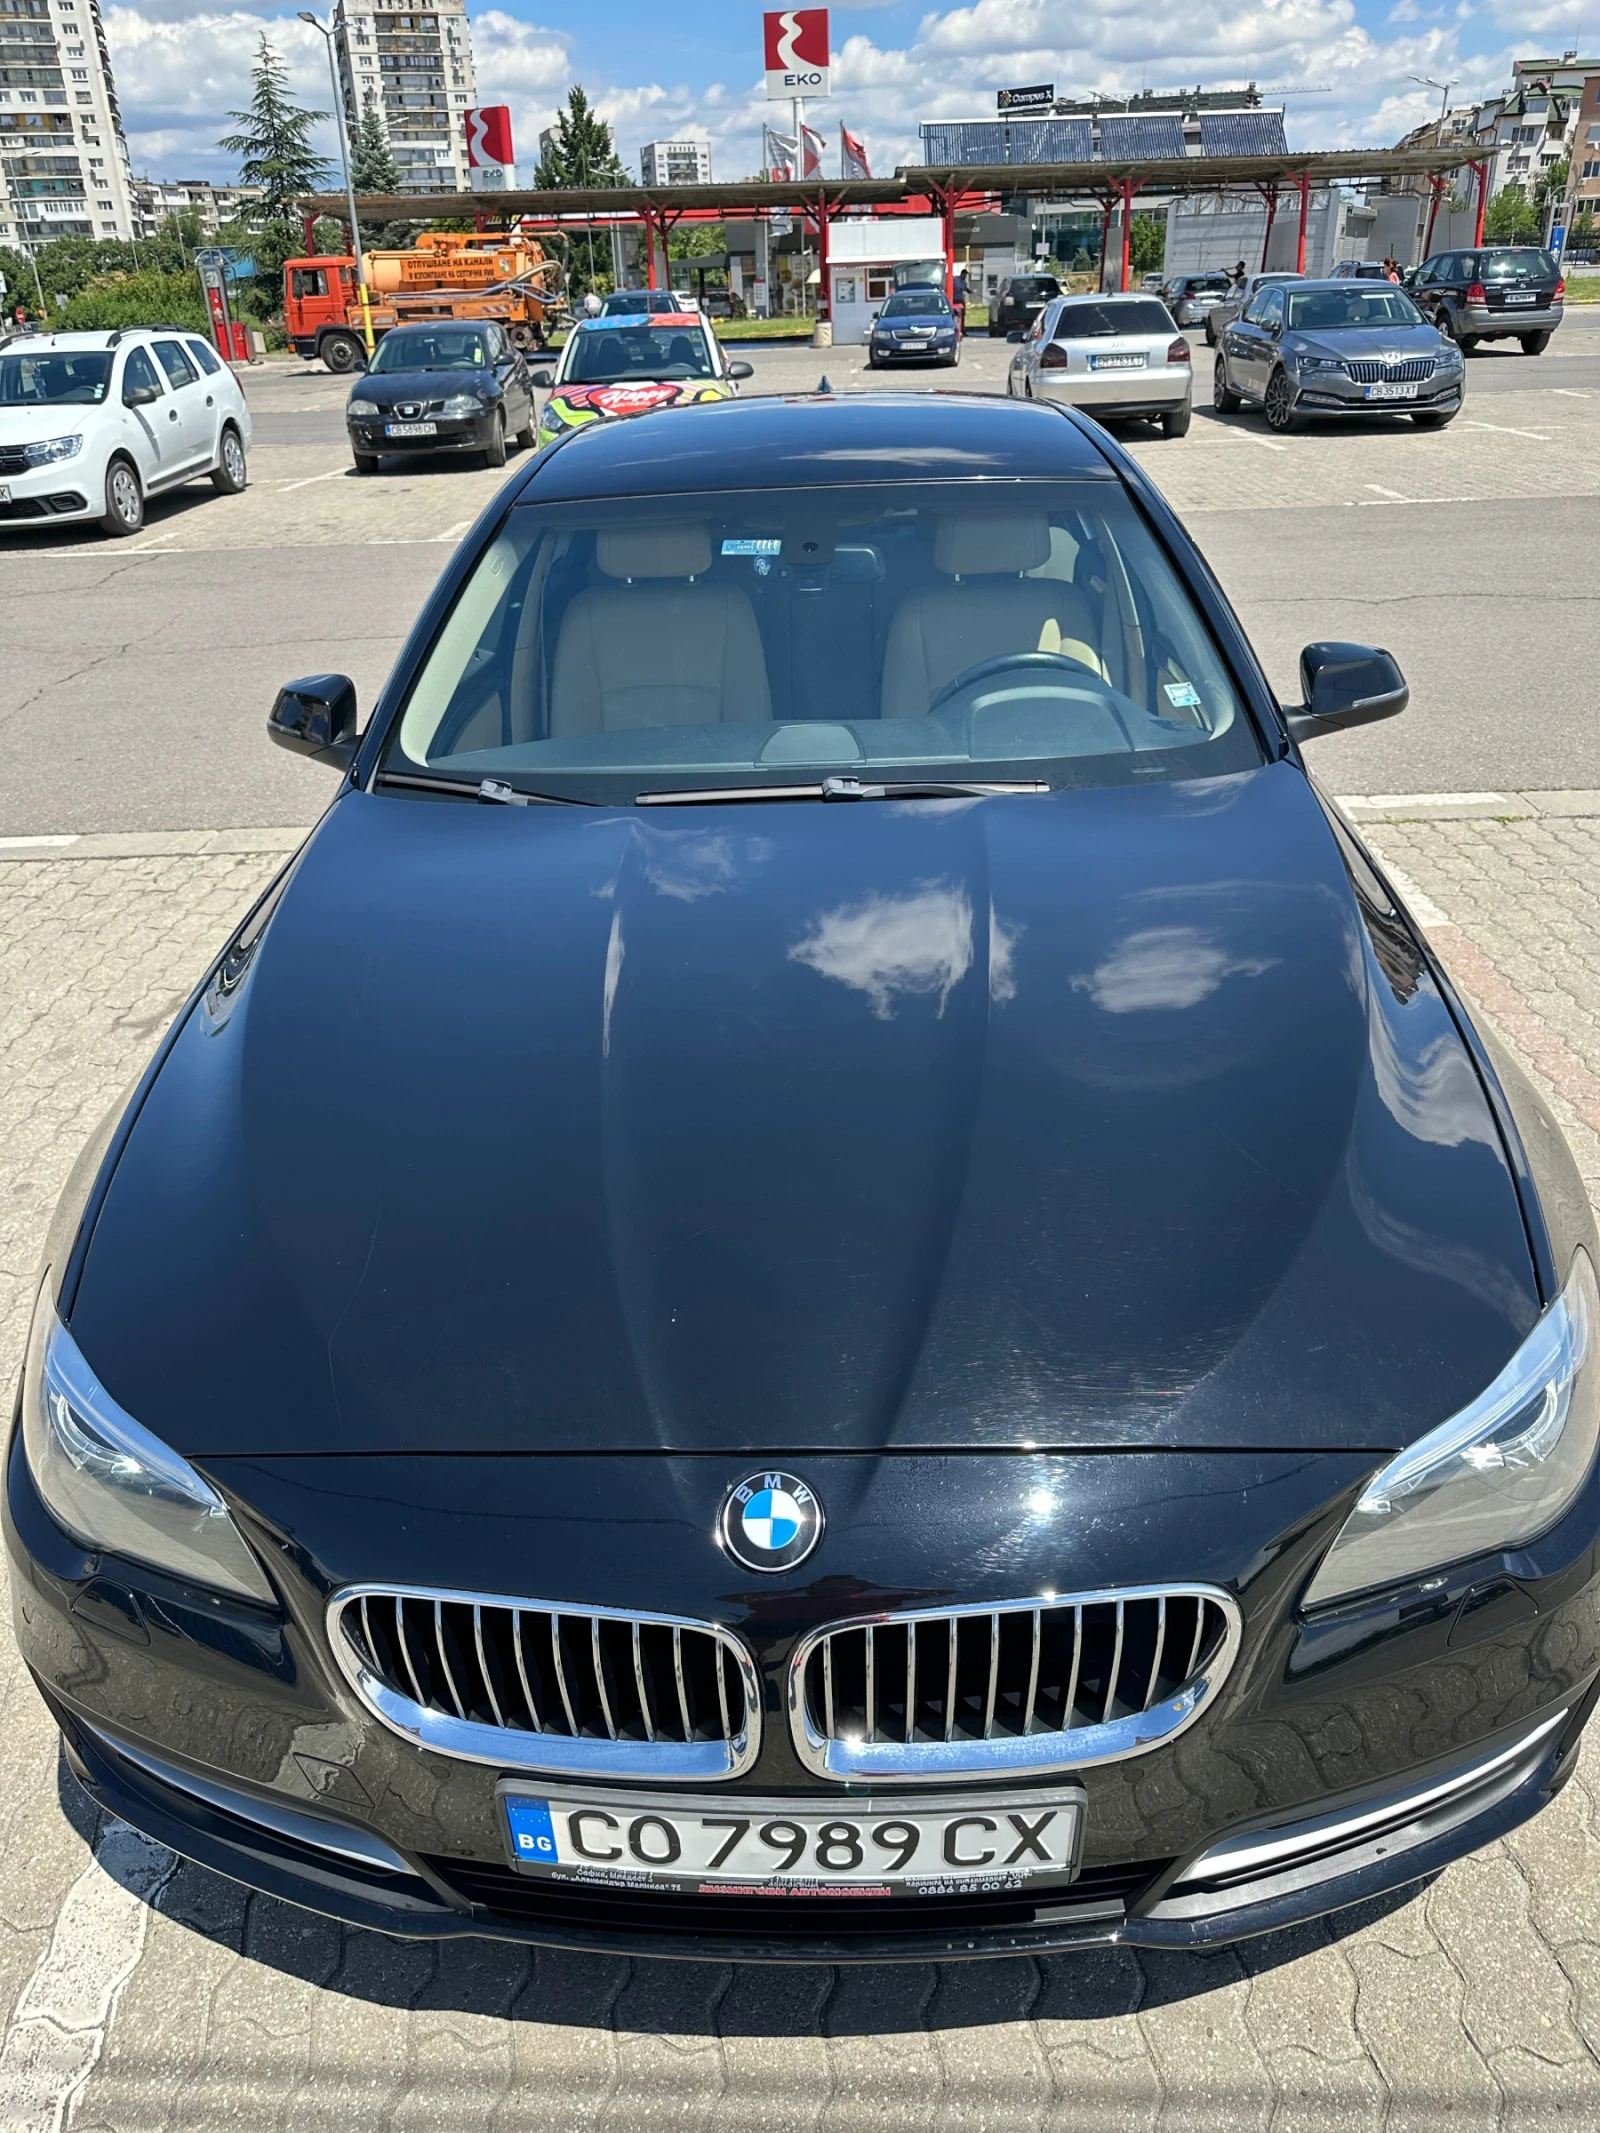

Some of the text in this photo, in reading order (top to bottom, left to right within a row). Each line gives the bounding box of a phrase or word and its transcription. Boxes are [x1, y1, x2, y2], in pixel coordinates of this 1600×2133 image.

[784, 73, 822, 86] EKO
[1012, 90, 1053, 103] Campus X
[482, 168, 503, 178] EKO
[407, 260, 451, 269] ОТПУШВАНЕ
[465, 258, 493, 266] КАНАЛИ
[598, 389, 673, 405] Happy
[734, 1474, 812, 1505] BMW
[518, 1809, 1059, 1872] BG CO 7989 CX
[698, 1883, 892, 1897] ЛИЗИНГОВИ АВТОМОБИЛИ
[918, 1879, 1022, 1895] 0886 85 00 62
